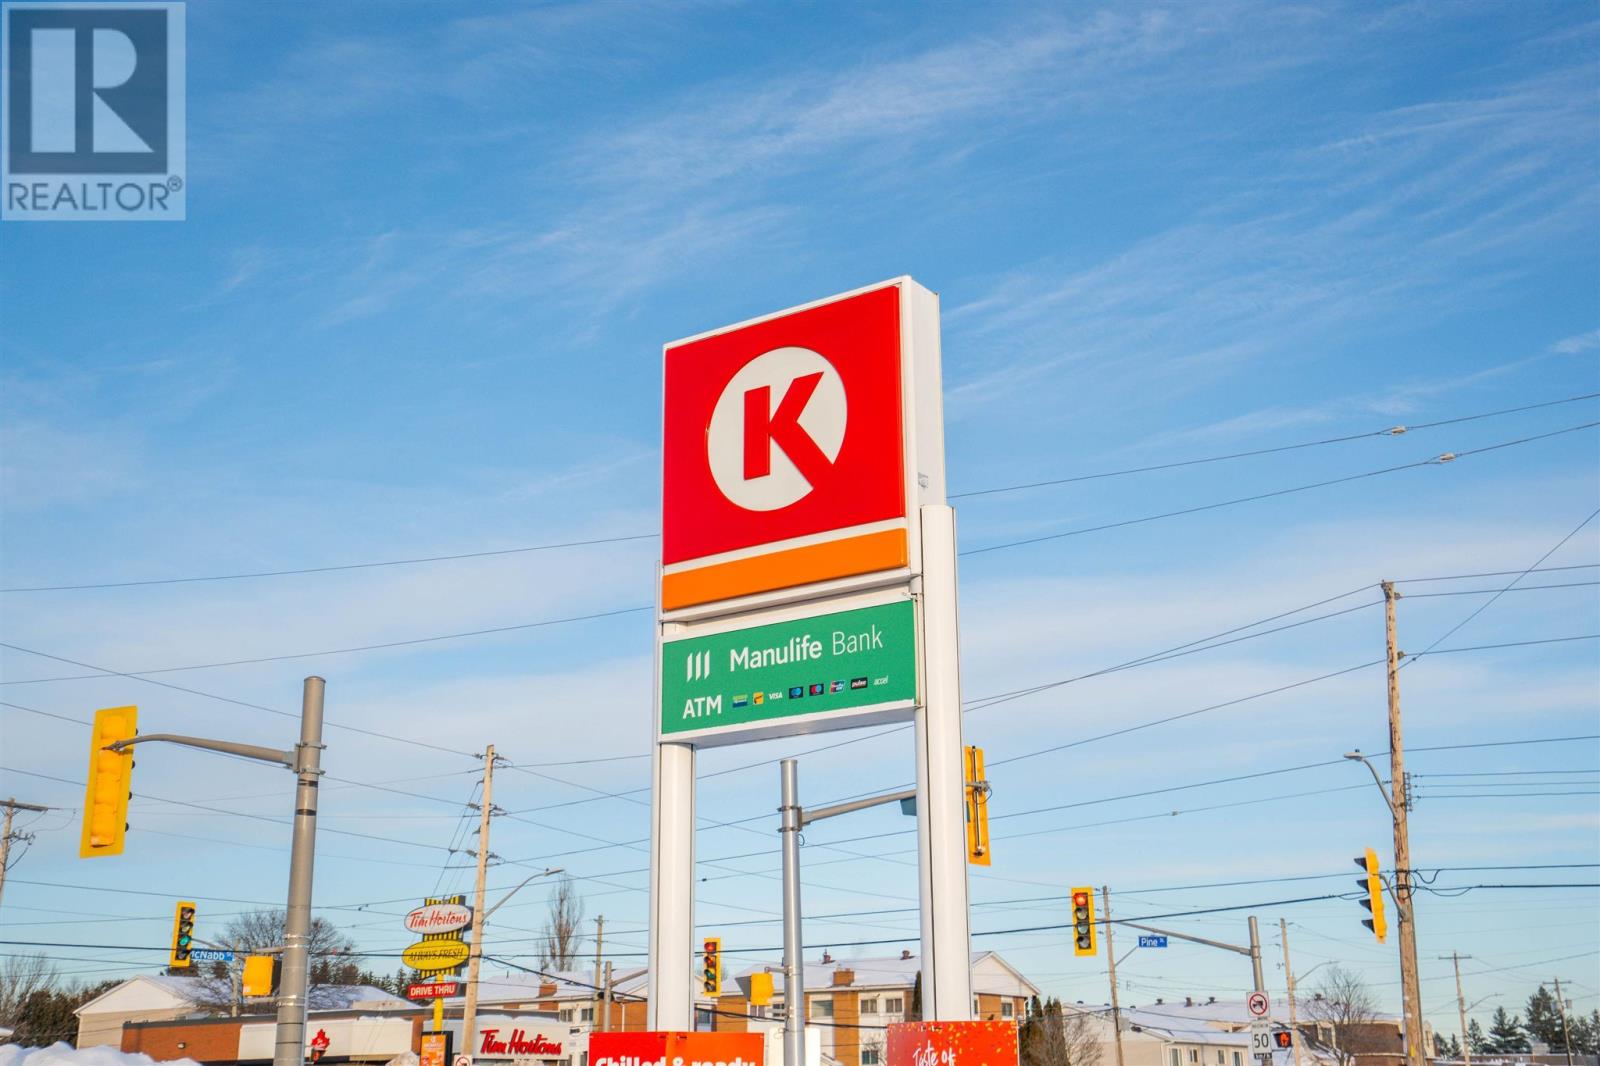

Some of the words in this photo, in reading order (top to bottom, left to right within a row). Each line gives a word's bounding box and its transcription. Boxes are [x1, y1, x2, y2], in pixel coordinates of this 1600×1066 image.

[730, 634, 822, 672] Manulife
[832, 624, 883, 656] Bank
[682, 694, 722, 719] ATM
[768, 692, 783, 700] VISA
[410, 911, 428, 929] Tim
[429, 910, 467, 926] Hortons
[1141, 937, 1158, 947] Pine
[438, 947, 464, 960] FRESH
[410, 986, 433, 996] DRIVE
[434, 985, 456, 995] THRU
[480, 1029, 507, 1055] Tim
[507, 1028, 562, 1055] Hortons
[1254, 1033, 1269, 1048] 50
[912, 1039, 939, 1066] Taste
[941, 1046, 956, 1066] of
